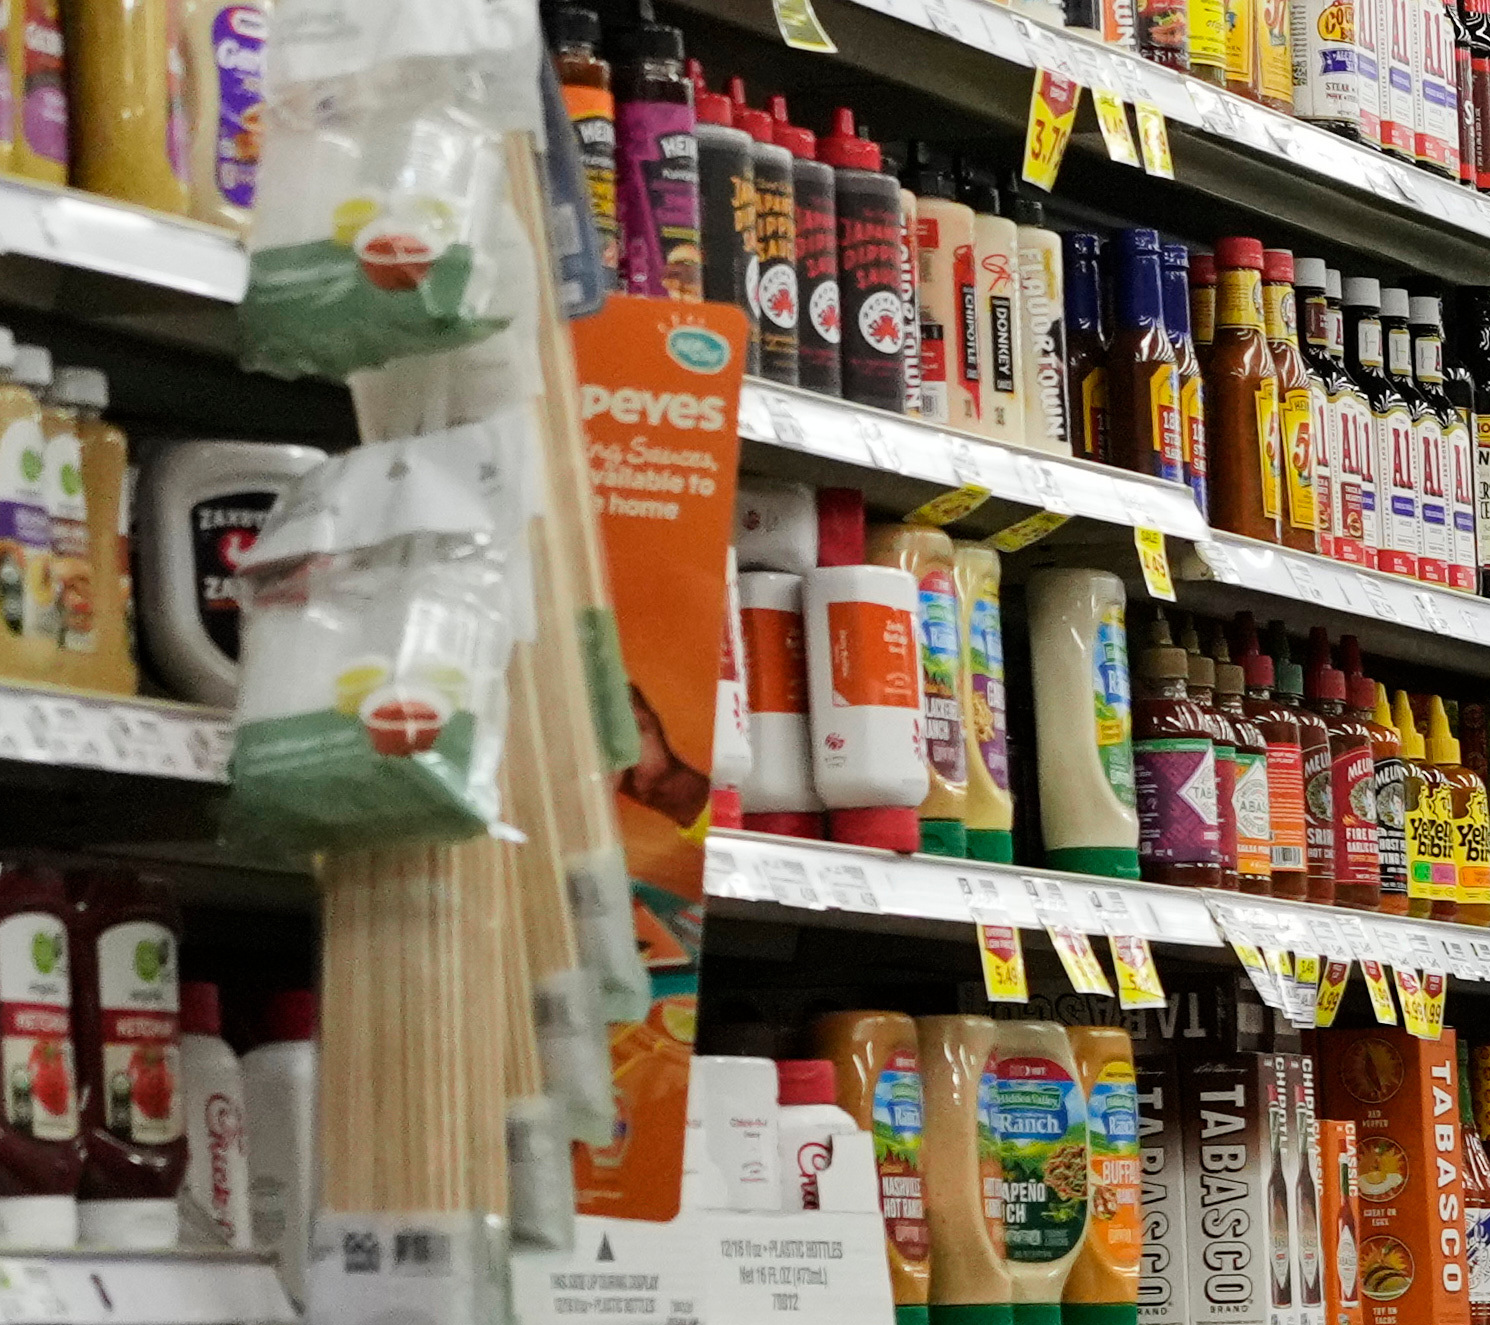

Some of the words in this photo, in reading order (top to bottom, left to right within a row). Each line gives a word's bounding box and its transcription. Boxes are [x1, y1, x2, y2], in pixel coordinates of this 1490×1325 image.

[964, 290, 977, 376] CHIPOTLE
[993, 303, 1011, 378] DONKEY
[610, 494, 680, 520] home
[689, 474, 716, 497] to
[1000, 1111, 1062, 1135] Ranch
[1345, 1122, 1358, 1198] CLASSIC
[1199, 1083, 1253, 1307] TABASCO
[1428, 1059, 1464, 1294] TABASCO
[1209, 1303, 1249, 1315] BRAND
